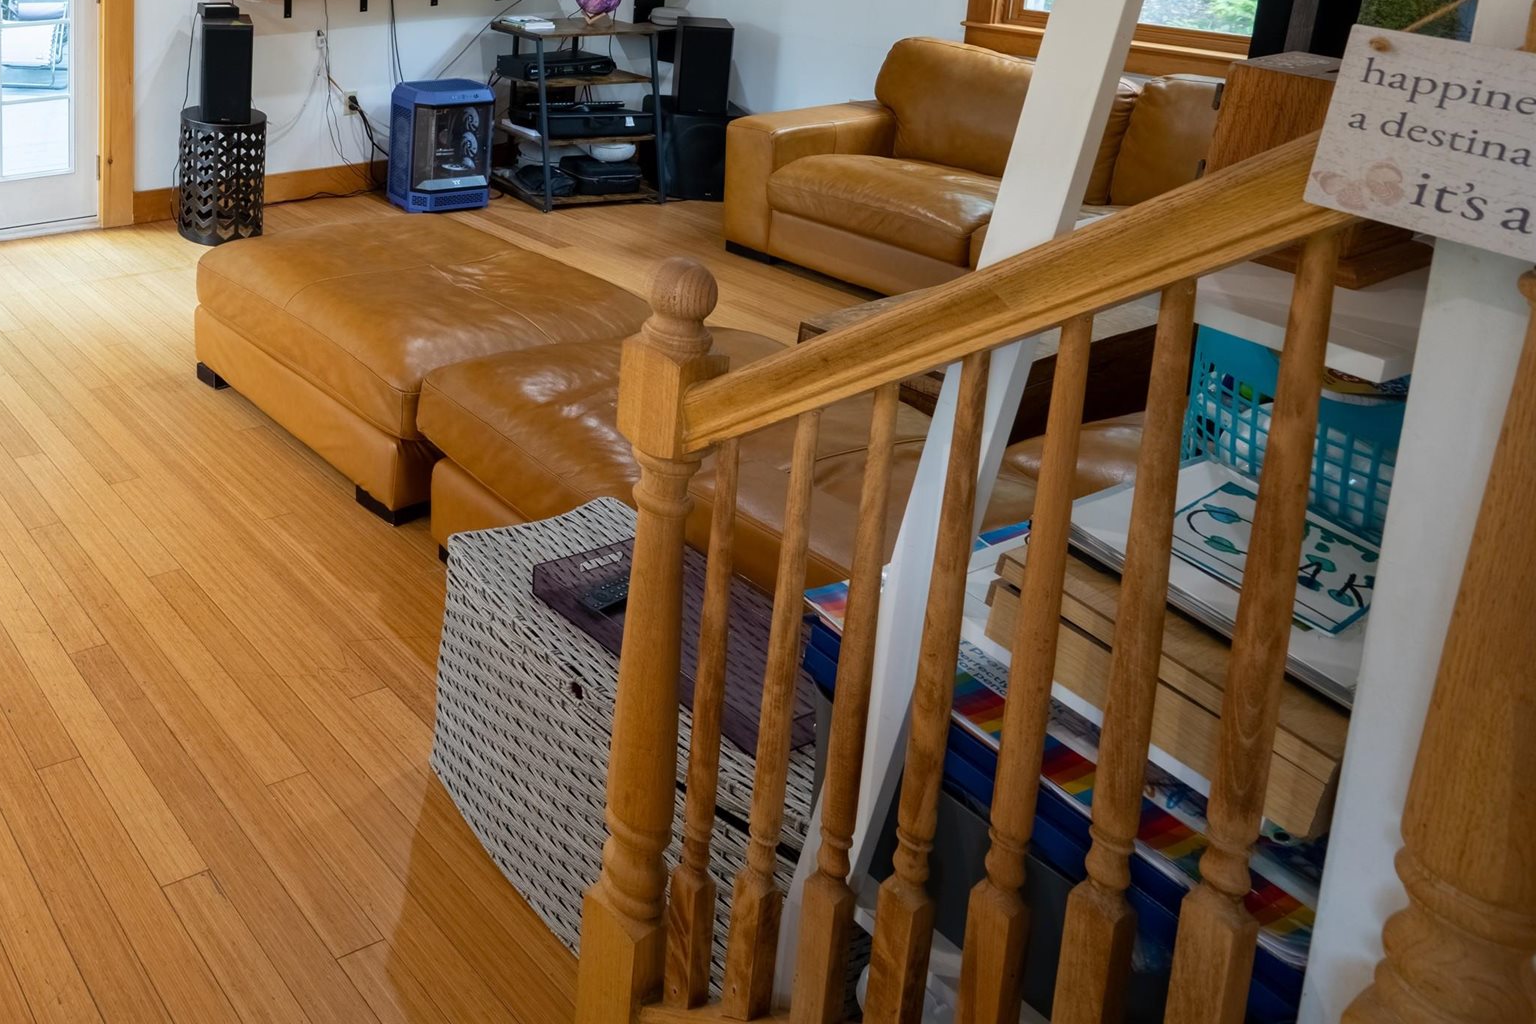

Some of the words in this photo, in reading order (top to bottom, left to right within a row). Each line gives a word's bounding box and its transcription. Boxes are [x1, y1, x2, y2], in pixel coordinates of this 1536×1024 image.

[1348, 111, 1367, 131] a
[1410, 173, 1488, 221] it's
[1500, 205, 1533, 235] a
